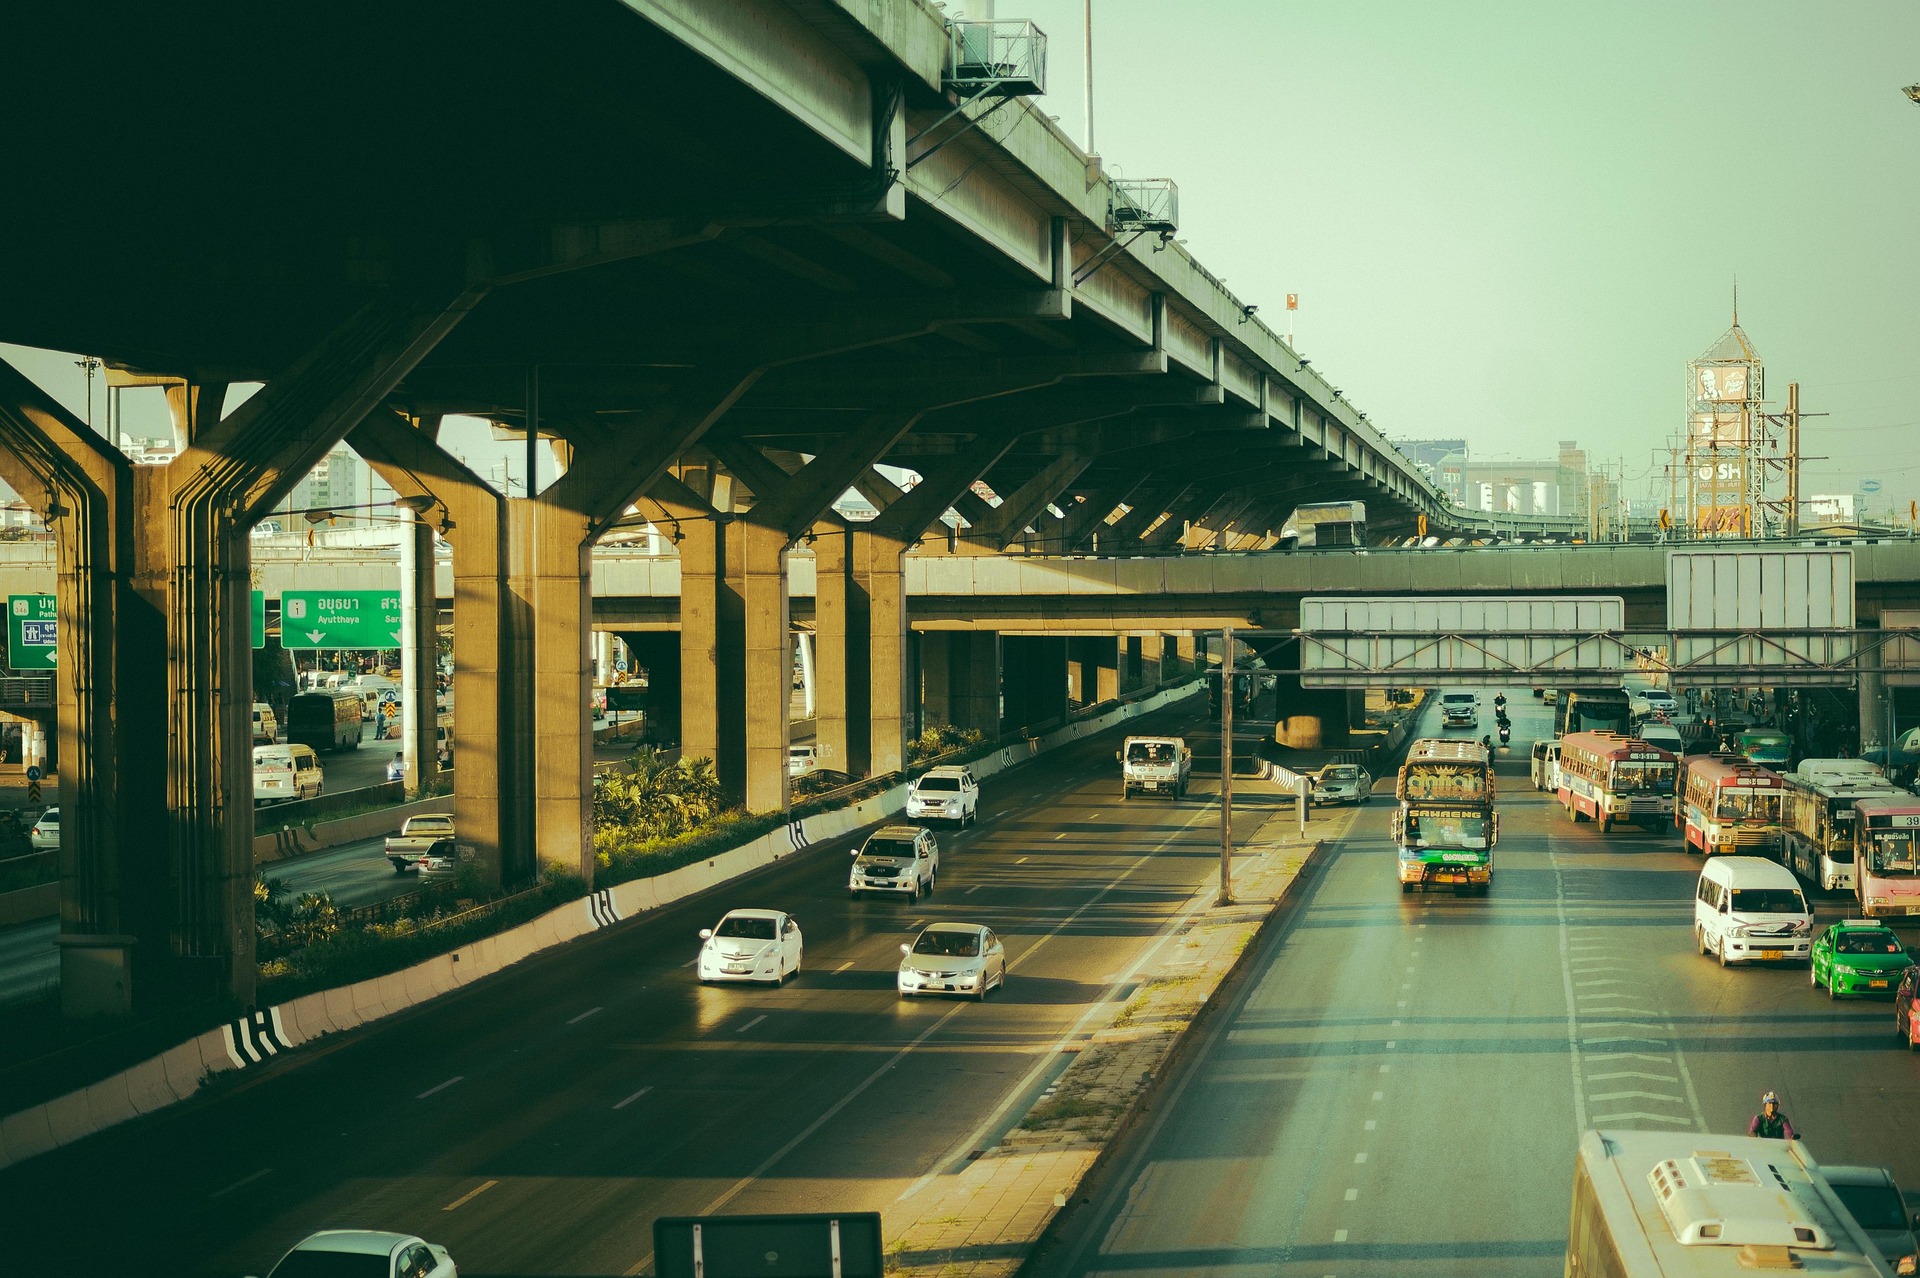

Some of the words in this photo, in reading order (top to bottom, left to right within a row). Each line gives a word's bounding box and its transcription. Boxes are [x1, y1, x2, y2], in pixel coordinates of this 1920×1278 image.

[38, 597, 55, 611] ปทุ
[318, 598, 359, 615] อยุธยา
[318, 615, 360, 625] Ayutthaya
[1409, 809, 1481, 819] SAWAENG
